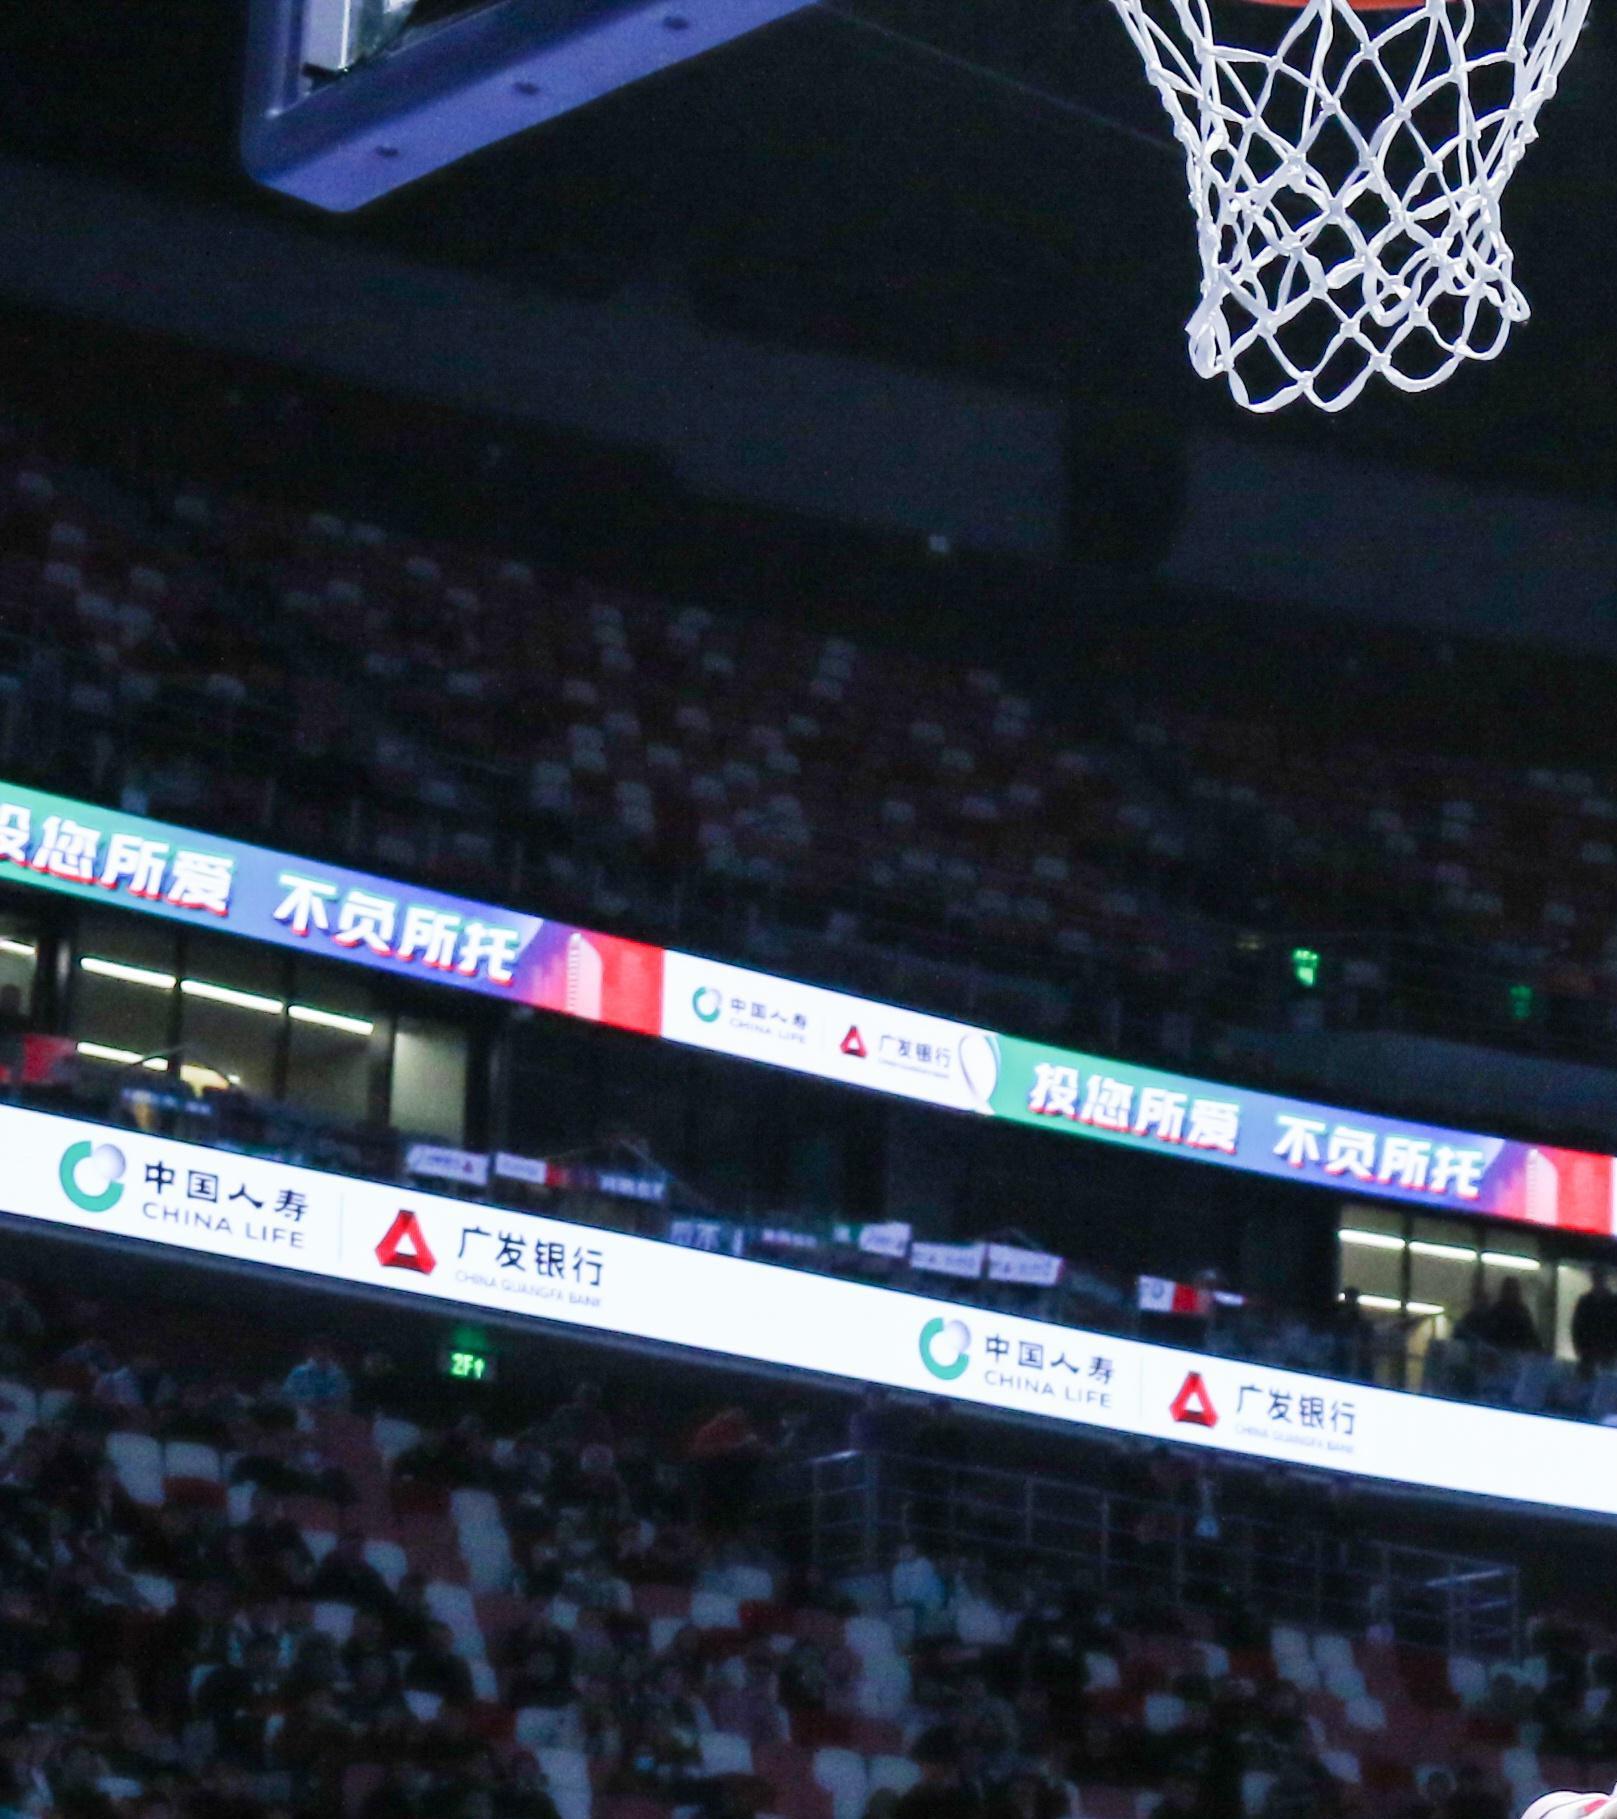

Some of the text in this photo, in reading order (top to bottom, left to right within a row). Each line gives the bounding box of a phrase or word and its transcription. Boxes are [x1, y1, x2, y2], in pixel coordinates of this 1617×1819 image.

[273, 873, 519, 986] 不负所托
[731, 997, 807, 1030] 中国人寿
[880, 1034, 951, 1068] 广发银行
[1029, 1062, 1484, 1200] 投您所爱 不负所托
[144, 1160, 309, 1222] 中国人寿
[143, 1202, 305, 1249] CHINA LIFE
[459, 1226, 605, 1287] 广发银行
[986, 1334, 1114, 1385] 中国人寿
[984, 1370, 1112, 1409] CHINA LIFE
[1236, 1384, 1356, 1436] 广发银行
